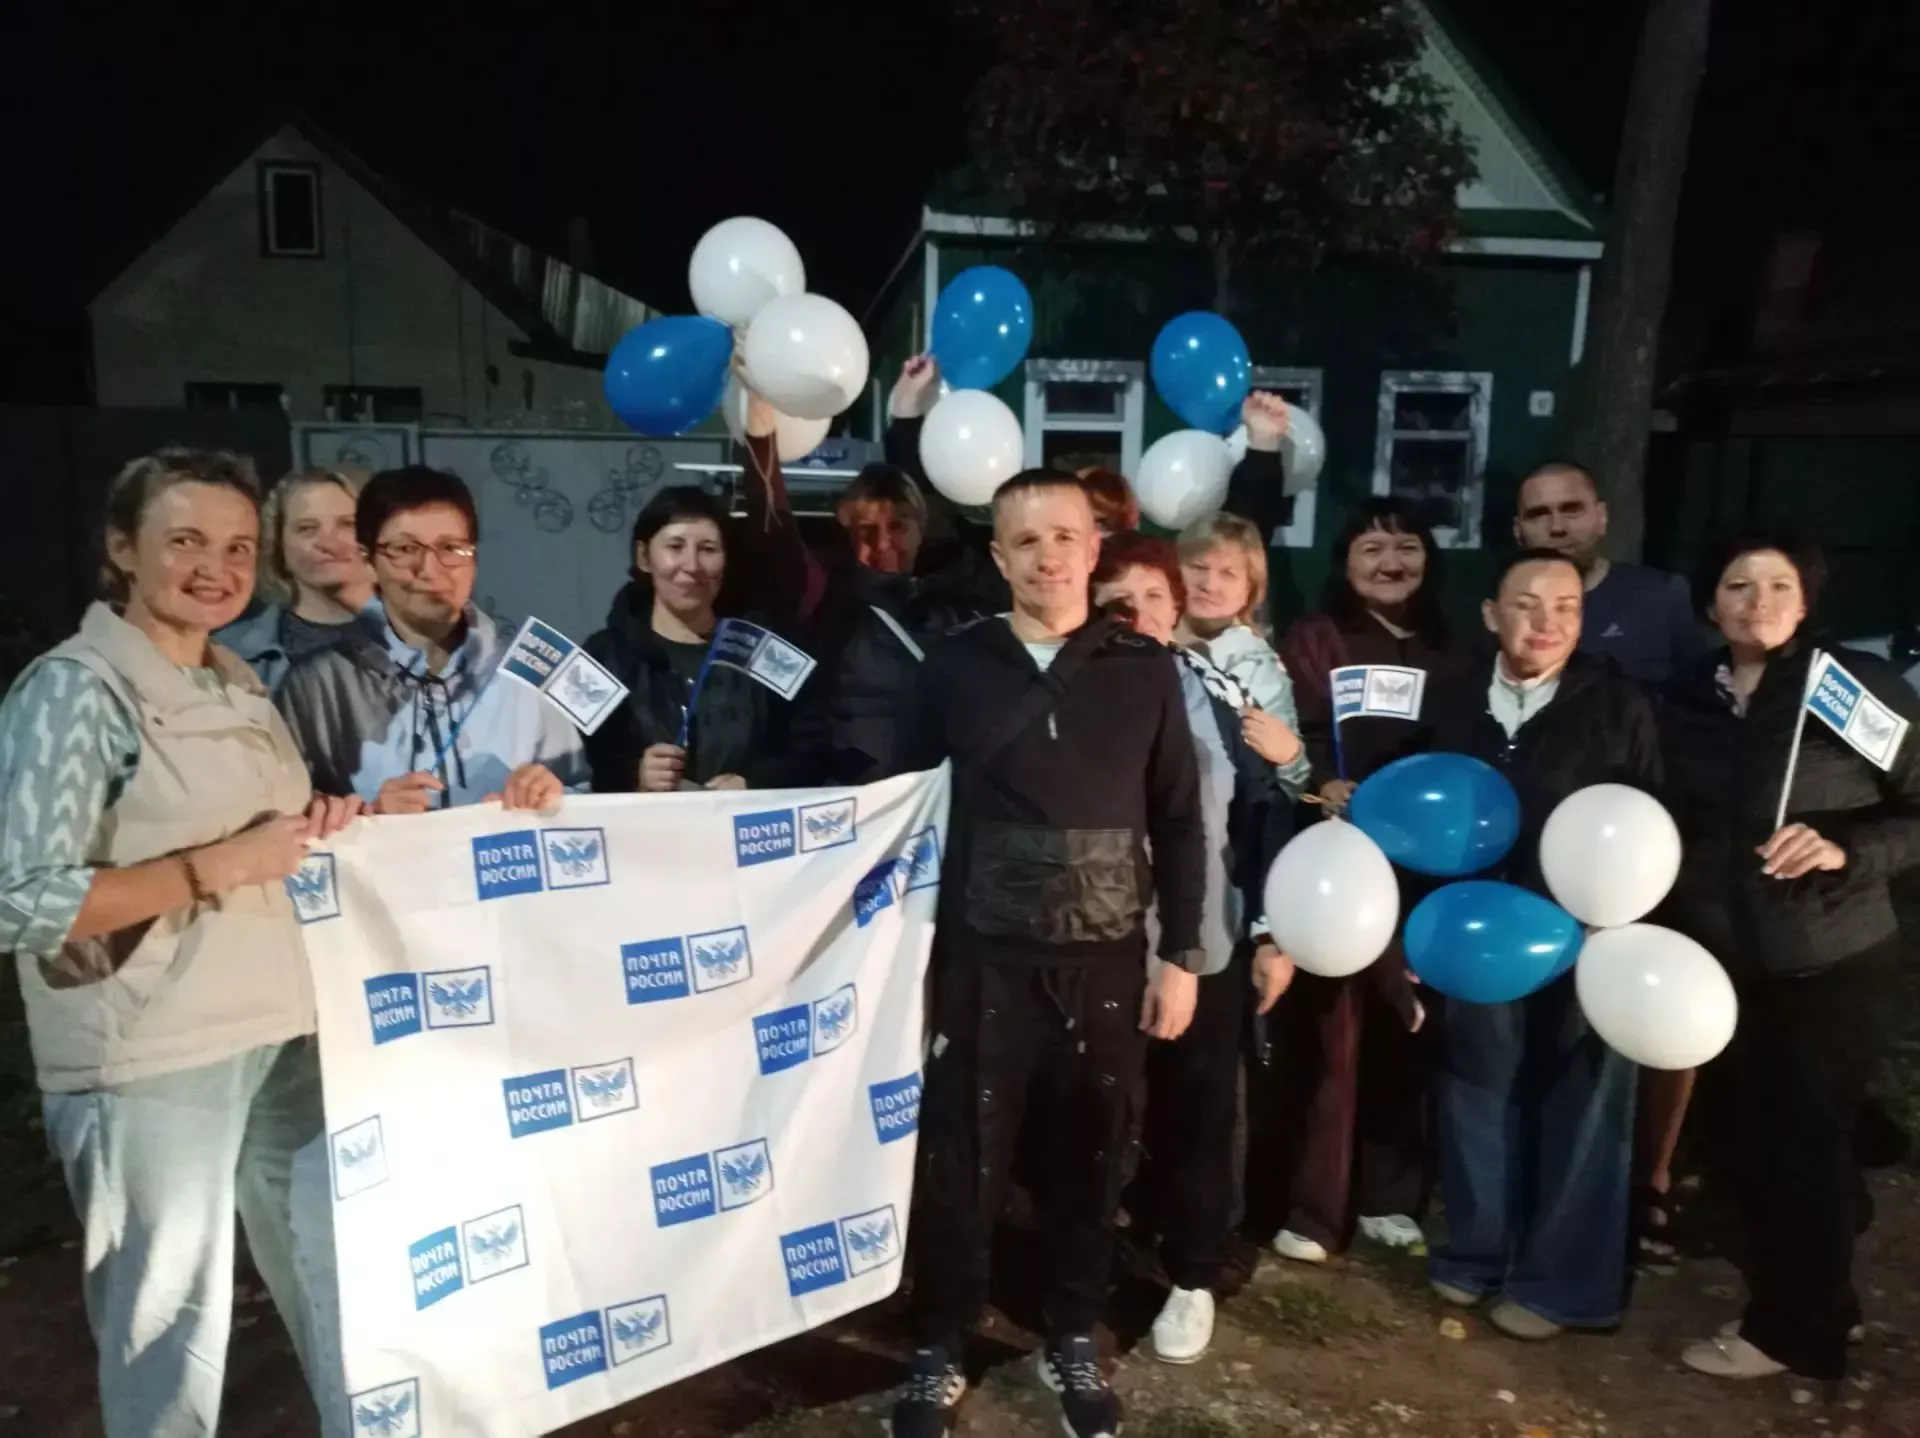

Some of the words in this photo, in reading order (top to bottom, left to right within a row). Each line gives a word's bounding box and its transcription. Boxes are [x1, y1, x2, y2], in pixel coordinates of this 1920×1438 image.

[738, 821, 791, 841] ПОЧТА
[478, 844, 535, 866] ПОЧТА
[739, 837, 793, 856] РОССИИ
[480, 864, 537, 885] РОССИИ
[627, 950, 681, 971] ПОЧТА
[629, 970, 684, 990] РОССИИ
[758, 1019, 808, 1043] ПОЧТА
[761, 1037, 808, 1061] РОССИИ
[508, 1081, 564, 1106] ПОЧТА
[875, 1085, 920, 1112] ПОЧТА
[511, 1100, 568, 1125] РОССИИ
[655, 1168, 708, 1194] ПОЧТА
[658, 1188, 711, 1213] РОССИИ
[412, 1241, 456, 1274] ПОЧТА
[786, 1236, 836, 1263] ПОЧТА
[790, 1255, 840, 1282] РОССИИ
[545, 1325, 599, 1355] ПОЧТА
[547, 1345, 602, 1374] РОССИИ
